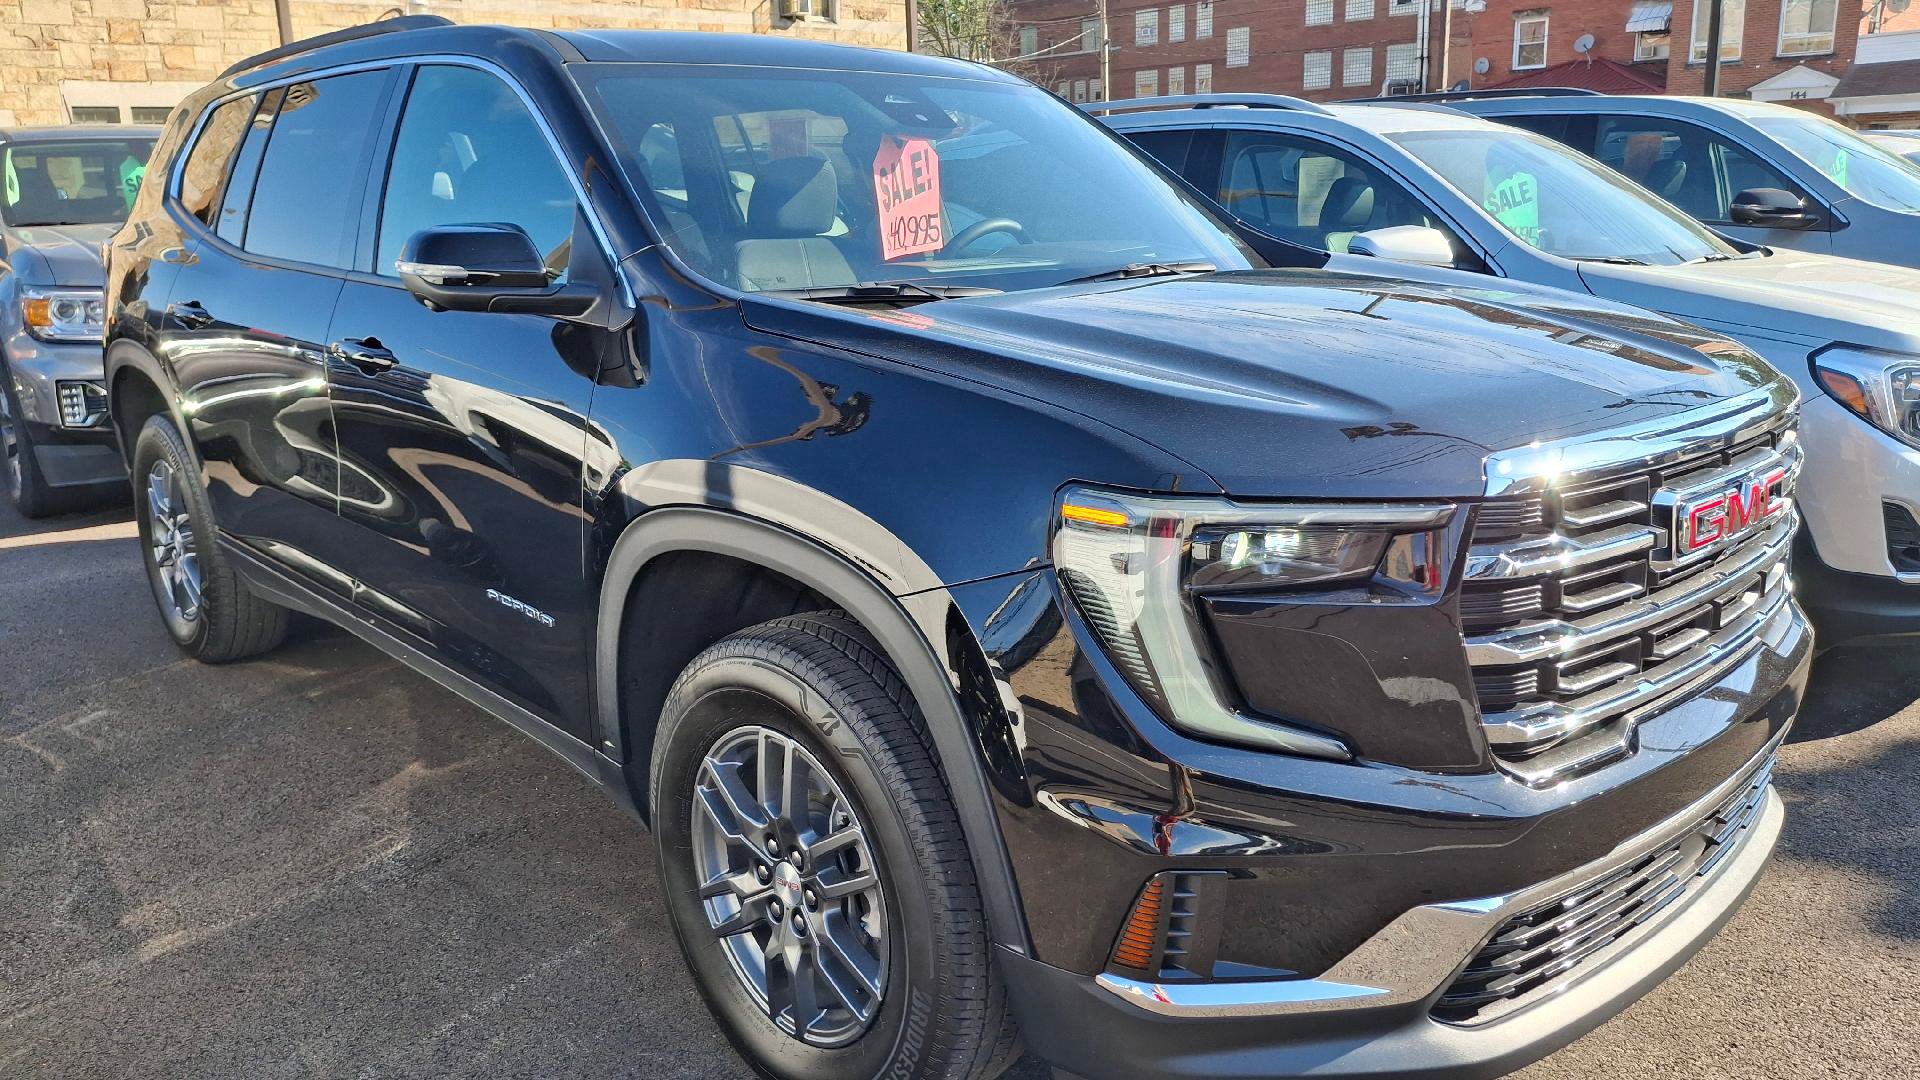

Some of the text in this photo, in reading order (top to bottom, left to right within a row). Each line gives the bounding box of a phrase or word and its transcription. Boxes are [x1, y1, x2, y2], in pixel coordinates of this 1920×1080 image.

[1790, 91, 1808, 99] 144
[880, 148, 932, 213] SALE!
[1487, 181, 1533, 214] SALE
[1688, 467, 1786, 549] GMC
[486, 588, 555, 628] ACADIA
